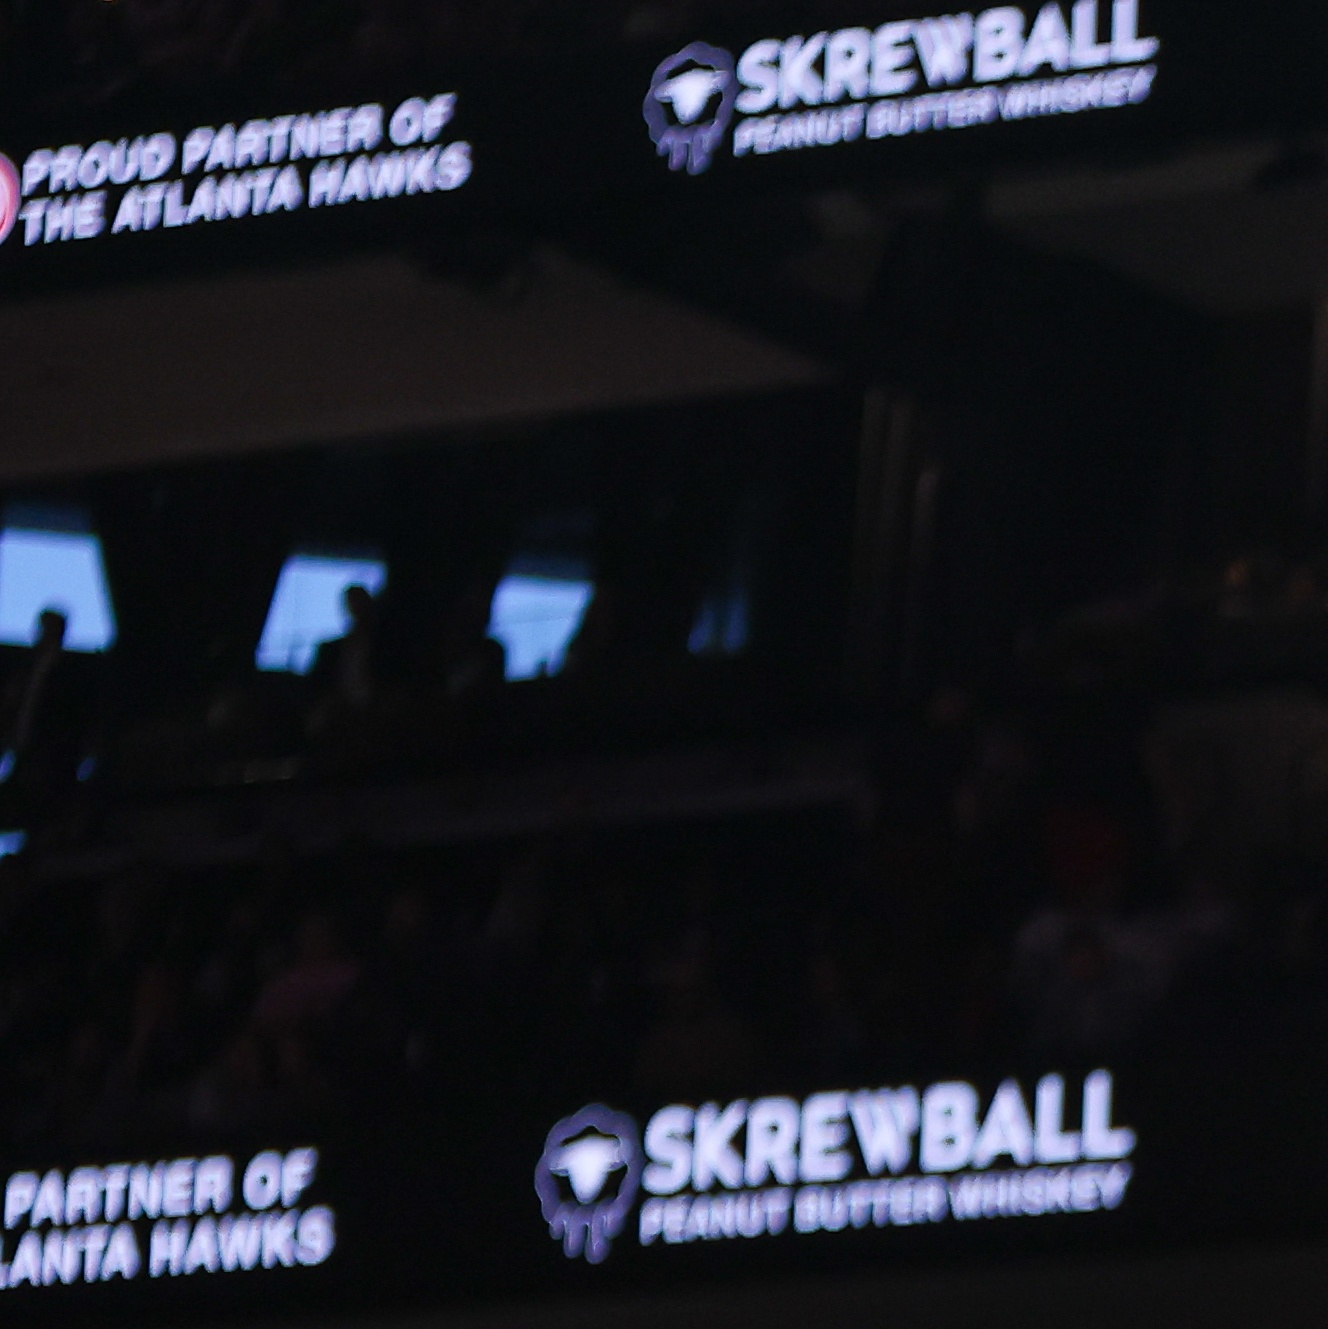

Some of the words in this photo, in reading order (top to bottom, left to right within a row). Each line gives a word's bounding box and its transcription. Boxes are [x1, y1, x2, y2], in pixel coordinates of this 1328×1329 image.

[734, 0, 1160, 113] SKREWBALL
[21, 132, 176, 196] PROUD
[182, 102, 385, 174] PARTNER
[389, 92, 458, 146] OF
[732, 102, 868, 157] PEANUT
[865, 85, 1000, 141] BUTTER
[1001, 63, 1158, 121] WHISKEY
[18, 190, 107, 246] THE
[111, 164, 302, 234] ATLANTA
[308, 141, 472, 208] HAWKS
[641, 1068, 1137, 1195] SKREWBALL
[4, 1155, 233, 1230] PARTNER
[242, 1146, 318, 1211] OF
[639, 1186, 793, 1247] PEANUT
[793, 1175, 949, 1235] BUTTER
[949, 1160, 1134, 1221] WHISKEY
[0, 1221, 141, 1291] ANTA
[149, 1204, 335, 1278] HAWKS
